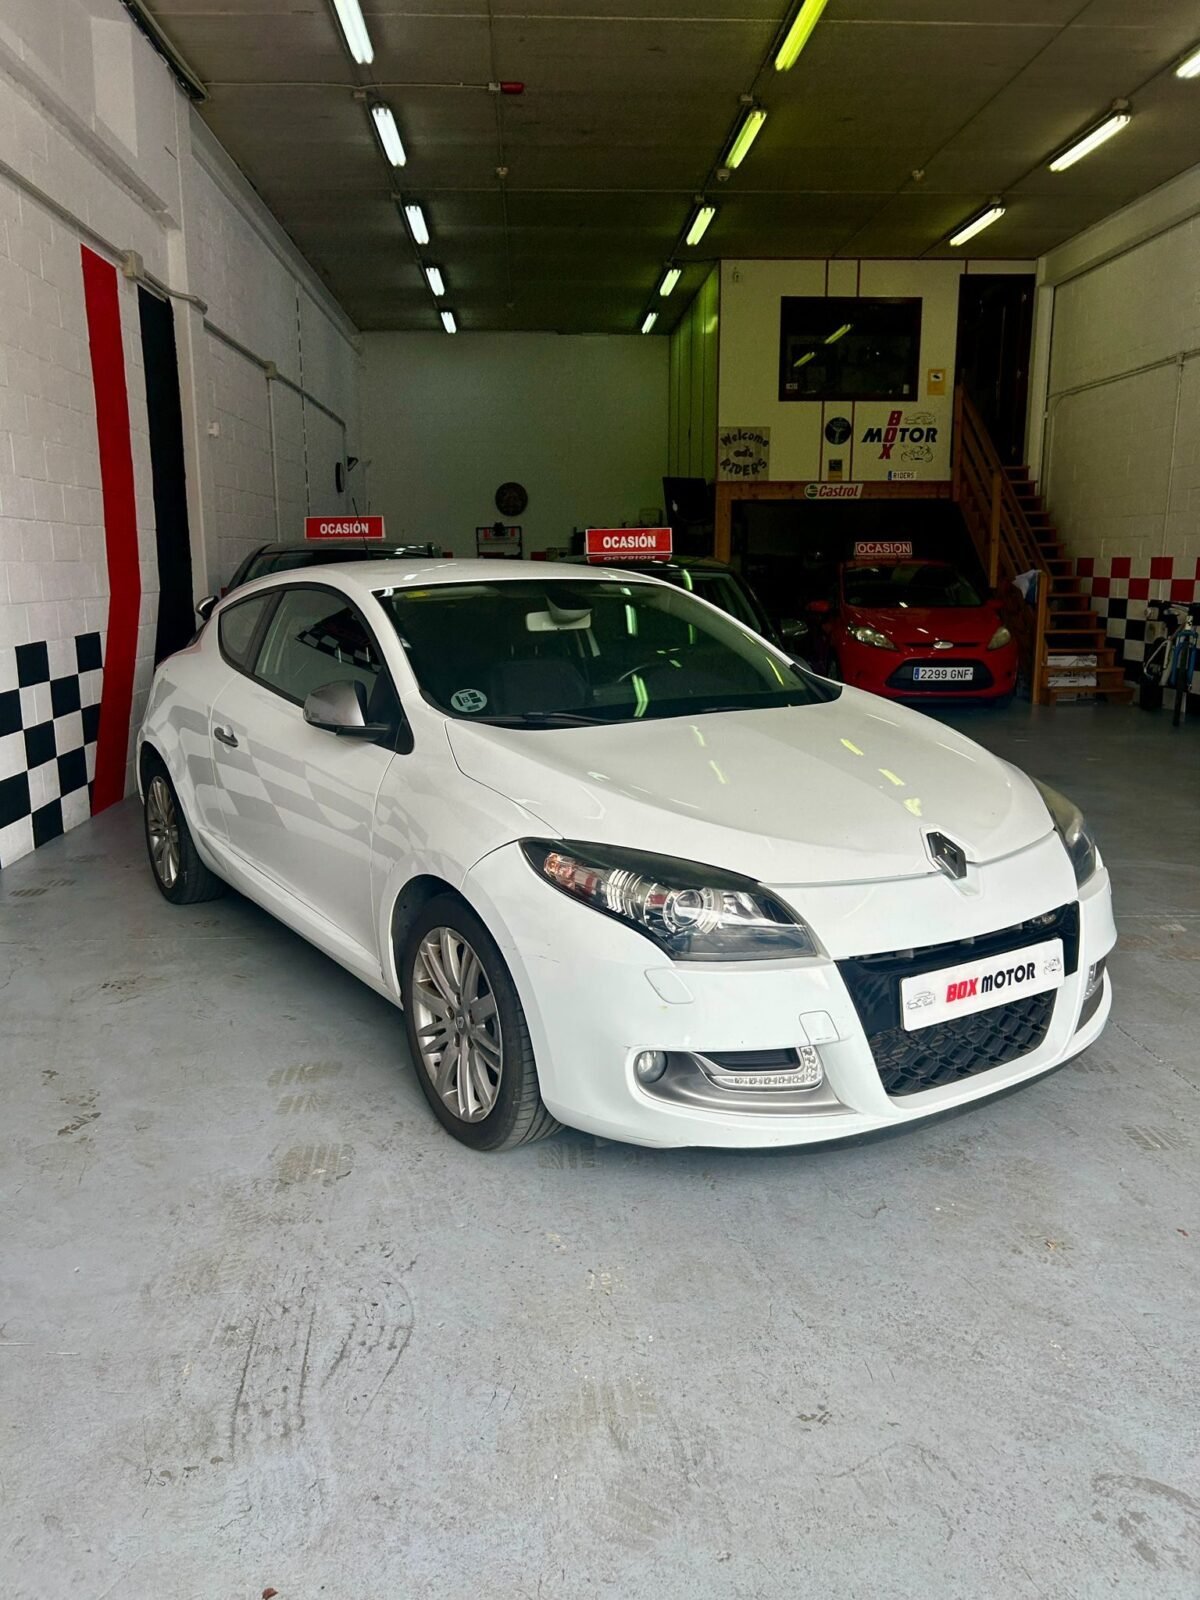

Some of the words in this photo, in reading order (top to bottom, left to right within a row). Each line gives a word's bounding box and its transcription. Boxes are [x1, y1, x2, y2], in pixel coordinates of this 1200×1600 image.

[720, 428, 769, 447] Welcome
[862, 427, 938, 442] MOTOR
[720, 458, 767, 476] RIDERS
[818, 485, 859, 497] Castrol
[320, 521, 369, 534] OCASIÓN
[602, 533, 656, 549] OCASIÓN
[920, 669, 948, 679] 2299
[950, 669, 970, 679] GNF
[461, 696, 470, 704] B
[945, 977, 979, 1003] BOX
[980, 962, 1036, 993] MOTOR
